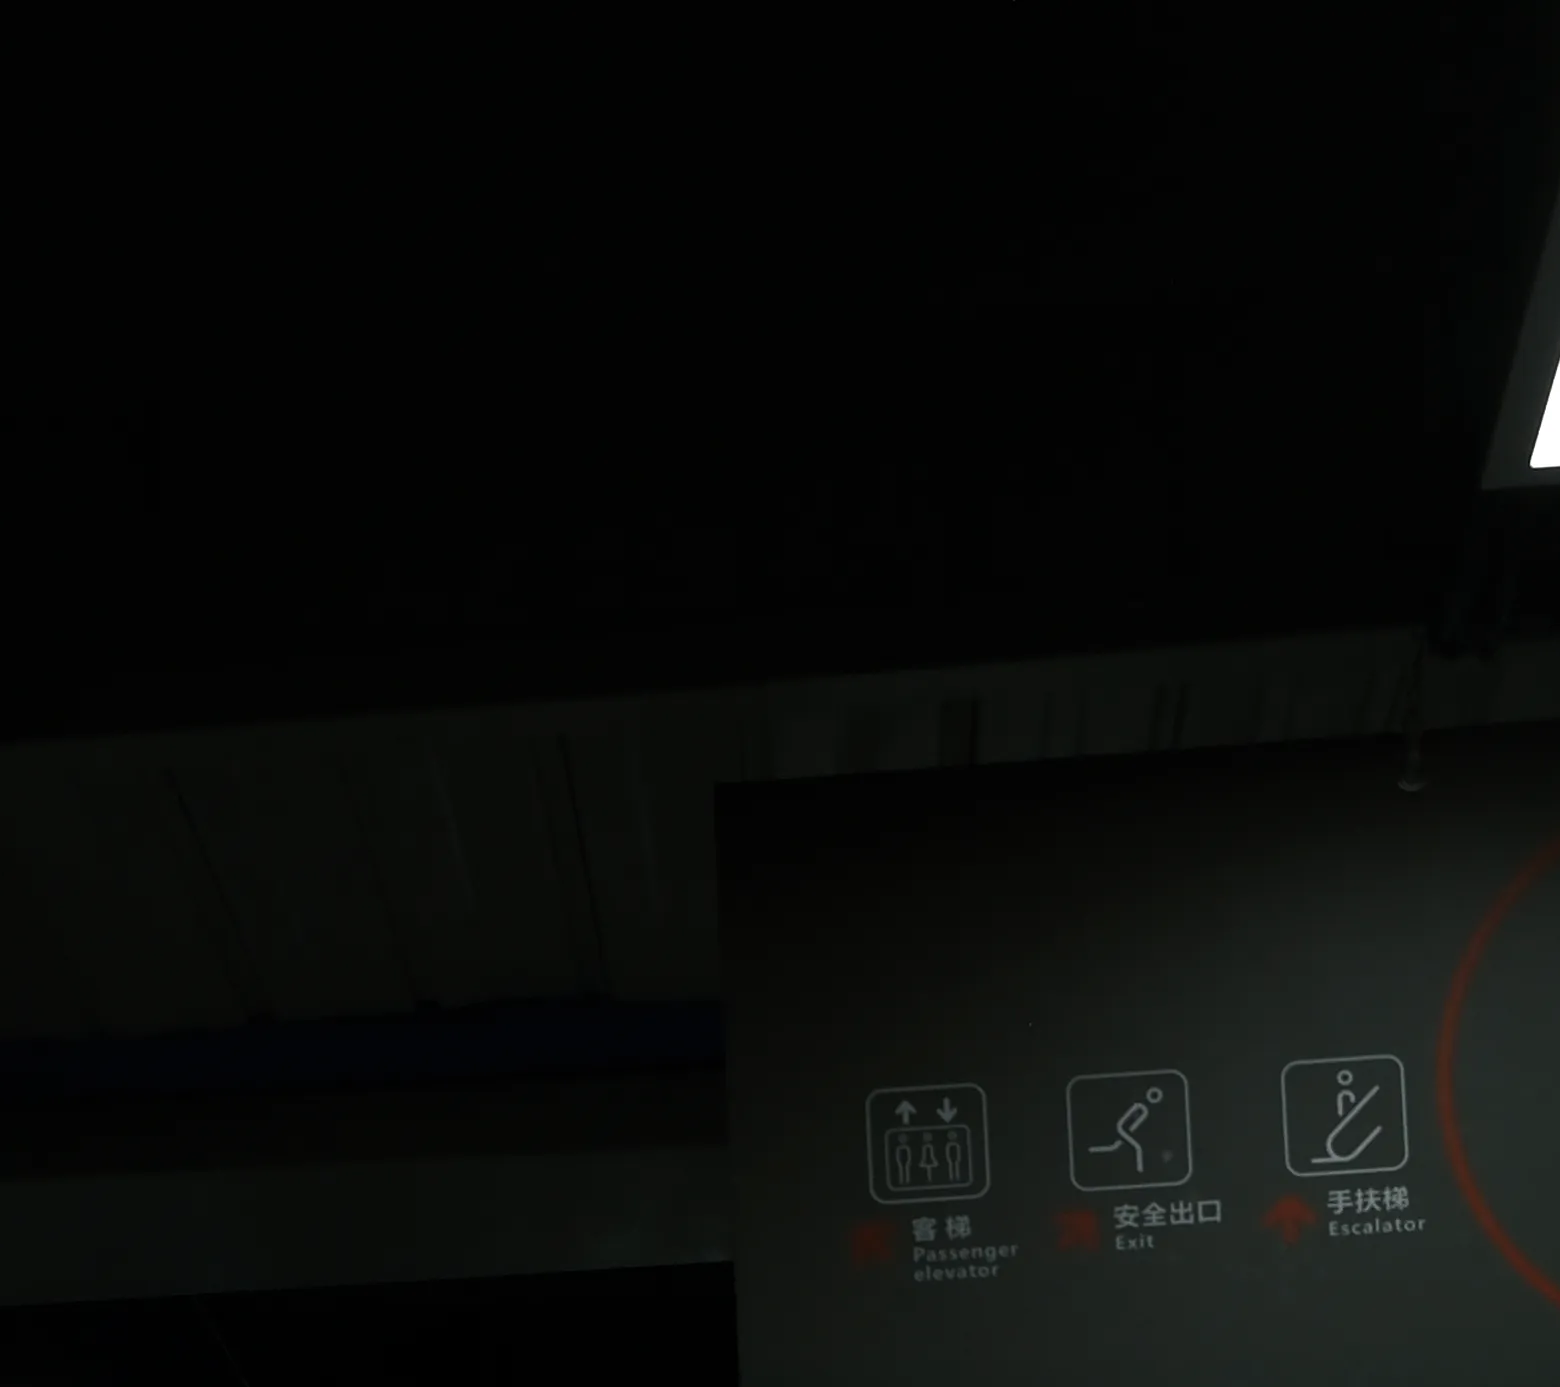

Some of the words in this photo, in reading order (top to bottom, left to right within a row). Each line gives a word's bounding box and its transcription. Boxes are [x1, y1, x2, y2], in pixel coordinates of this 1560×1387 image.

[1326, 1186, 1410, 1215] 手扶梯
[911, 1214, 973, 1243] 客梯
[1112, 1199, 1224, 1231] 安全出口
[1326, 1212, 1428, 1239] Escalator
[911, 1239, 1020, 1267] Passenger
[1113, 1231, 1156, 1253] Exit
[912, 1261, 1001, 1283] elevator
